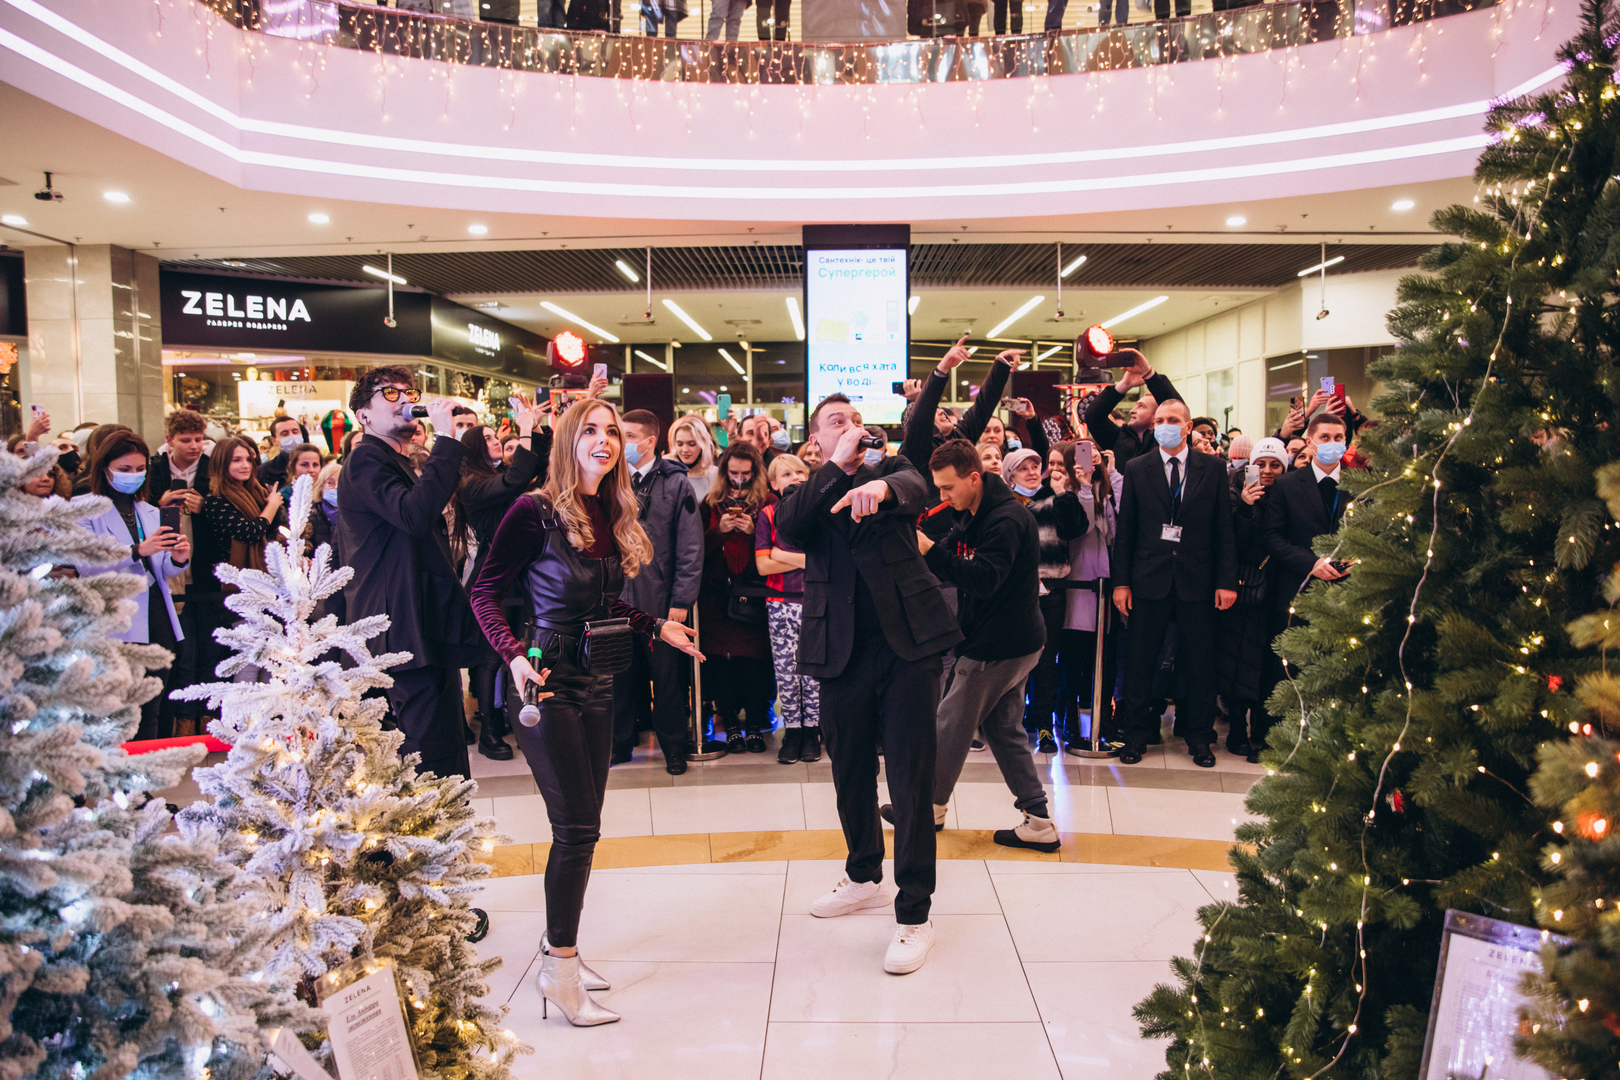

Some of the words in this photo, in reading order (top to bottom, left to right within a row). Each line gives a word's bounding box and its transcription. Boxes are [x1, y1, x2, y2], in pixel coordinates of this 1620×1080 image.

[818, 267, 896, 280] Супергерой
[181, 290, 312, 322] ZELENA
[468, 323, 500, 351] ZELENA
[819, 363, 847, 373] Коли
[849, 363, 870, 373] вся
[872, 363, 897, 371] хата
[268, 384, 318, 395] ZELENA
[837, 378, 844, 388] у
[1488, 949, 1537, 967] ZELENA
[344, 985, 371, 1003] ZELENA
